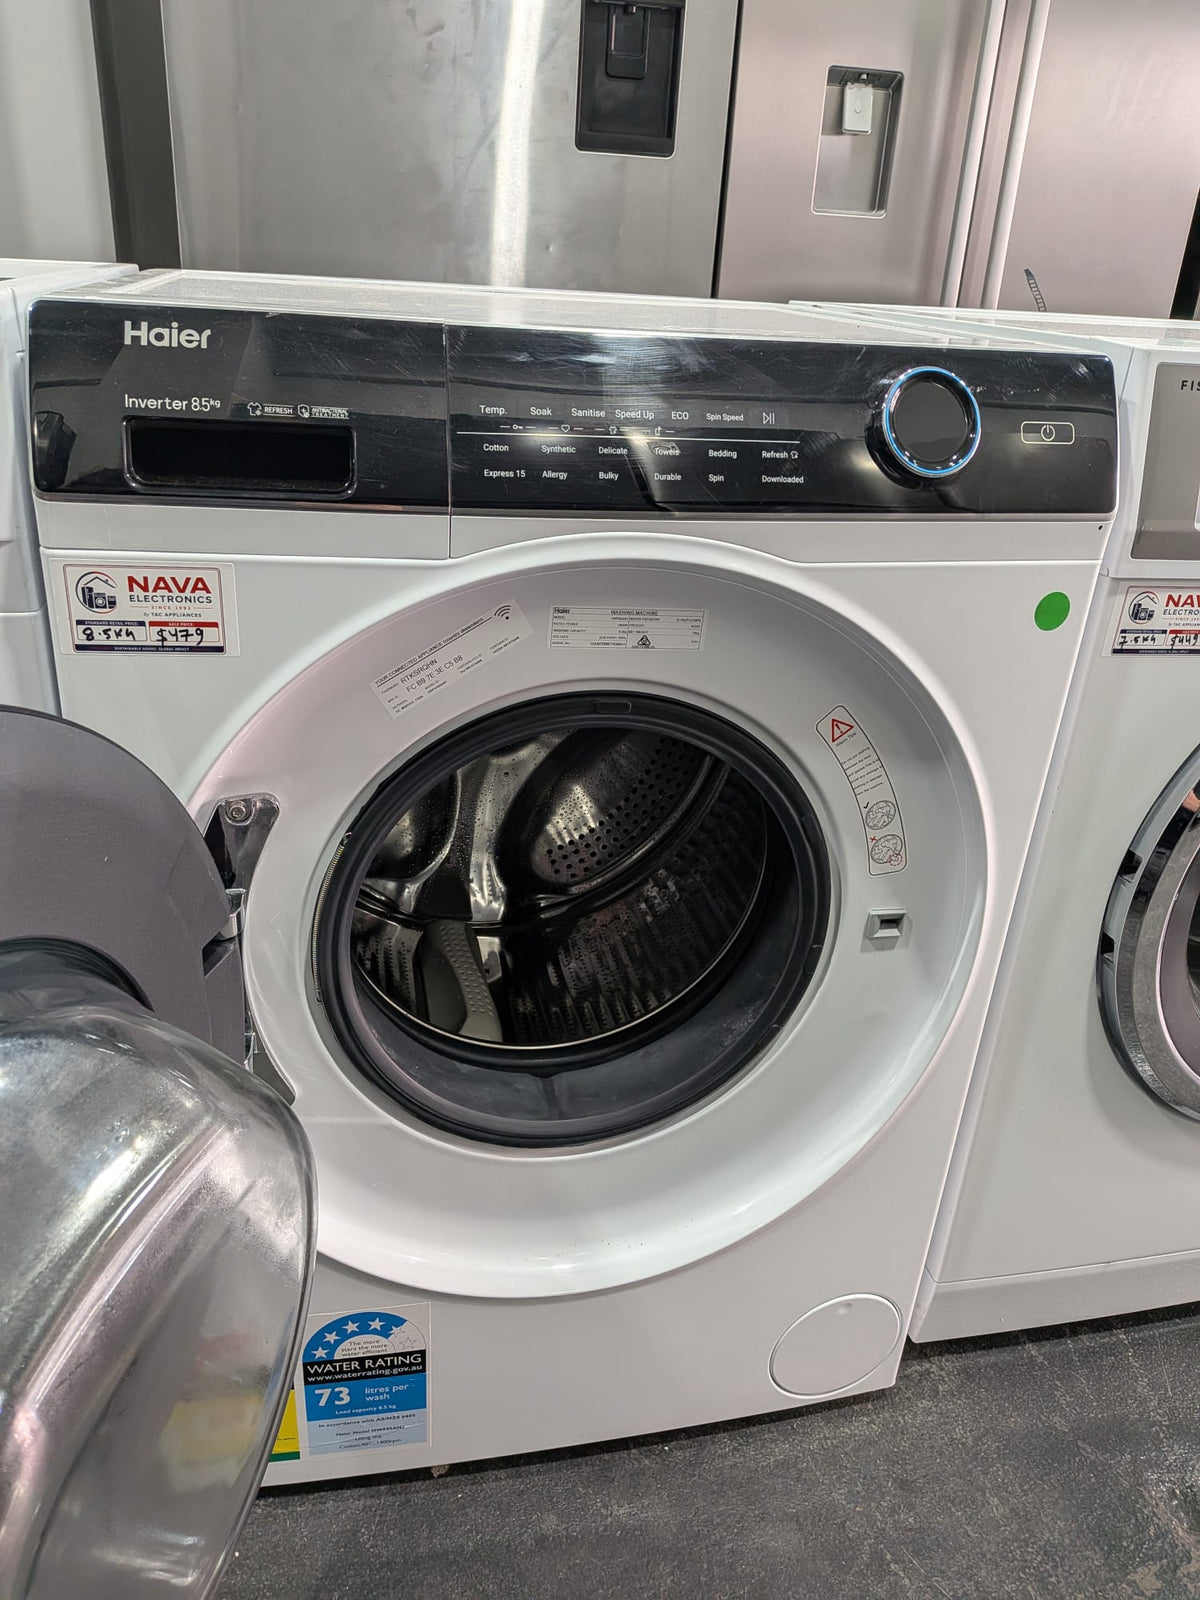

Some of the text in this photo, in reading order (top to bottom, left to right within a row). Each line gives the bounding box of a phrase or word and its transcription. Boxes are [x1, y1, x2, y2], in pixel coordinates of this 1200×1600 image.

[124, 320, 212, 349] Haier
[125, 393, 188, 411] Inverter
[264, 406, 293, 415] REFRESH
[479, 404, 508, 416] Temp.
[530, 406, 552, 416] Soak
[571, 407, 606, 418] Sanitise
[615, 409, 654, 421] Speed Up
[671, 411, 689, 421] ECO
[706, 413, 744, 422] Spin Speed
[483, 443, 509, 452] Cotton
[541, 444, 576, 454] Synthetic
[598, 446, 628, 455] Delicate
[654, 447, 680, 456] Towels
[708, 449, 737, 459] Bedding
[762, 451, 789, 459] Refresh
[484, 469, 526, 478] Express 15
[542, 470, 568, 480] Allergy
[599, 471, 619, 481] Bulky
[654, 472, 682, 481] Durable
[708, 474, 725, 482] Spin
[762, 475, 804, 484] Downloaded
[127, 575, 212, 594] NAVA
[129, 594, 212, 604] ELECTRONICS
[1165, 594, 1200, 608] NA
[156, 628, 205, 646] $479
[374, 674, 389, 686] YOUR
[389, 657, 417, 677] CONNECTED
[417, 641, 443, 661] APPLIANCE
[406, 683, 417, 693] FC
[417, 677, 426, 687] B9
[427, 672, 435, 682] 7E
[435, 667, 445, 677] 3E
[444, 661, 454, 671] C5
[453, 655, 464, 665] B8
[307, 1354, 422, 1374] WATER RATING
[307, 1364, 423, 1382] www.waterrating.gov.au
[365, 1383, 409, 1395] litres per
[314, 1386, 350, 1407] 73
[365, 1393, 390, 1402] wash
